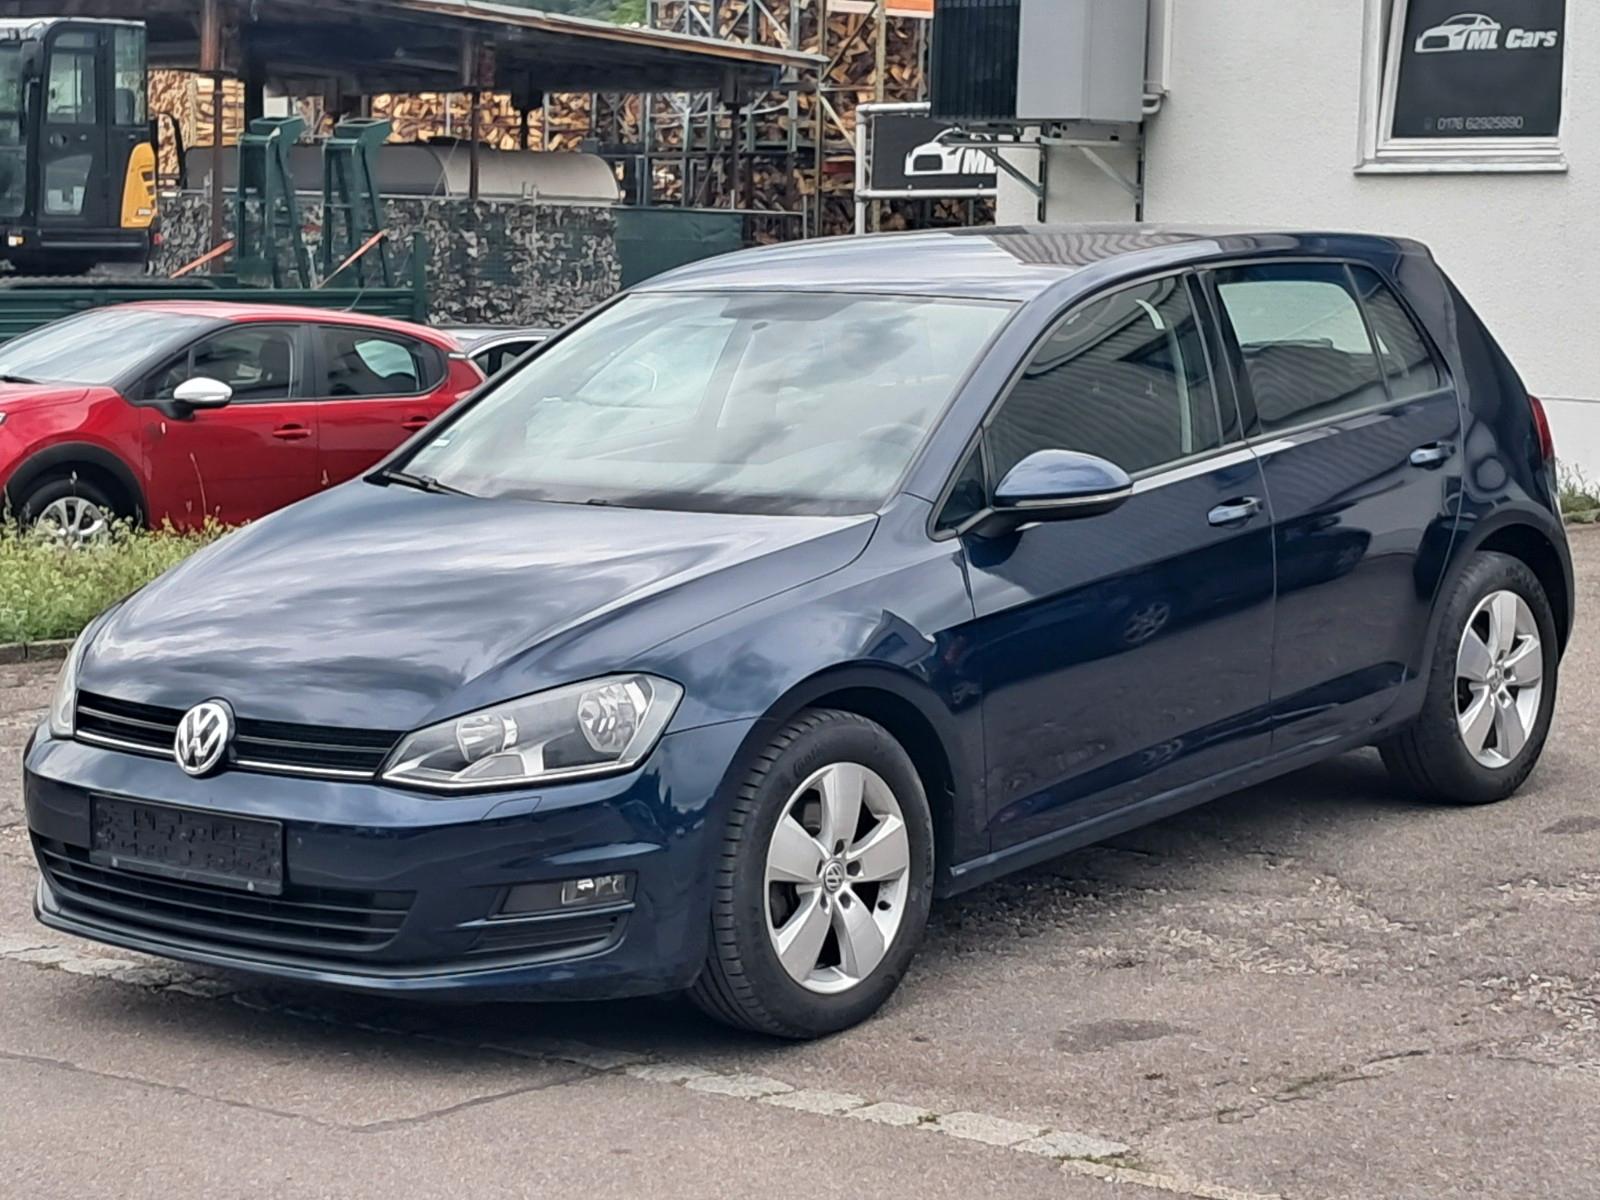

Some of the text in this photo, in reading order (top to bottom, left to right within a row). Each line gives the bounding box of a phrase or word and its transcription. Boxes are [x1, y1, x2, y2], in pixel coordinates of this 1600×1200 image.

[1467, 28, 1557, 50] ML Cars
[175, 703, 229, 775] VW
